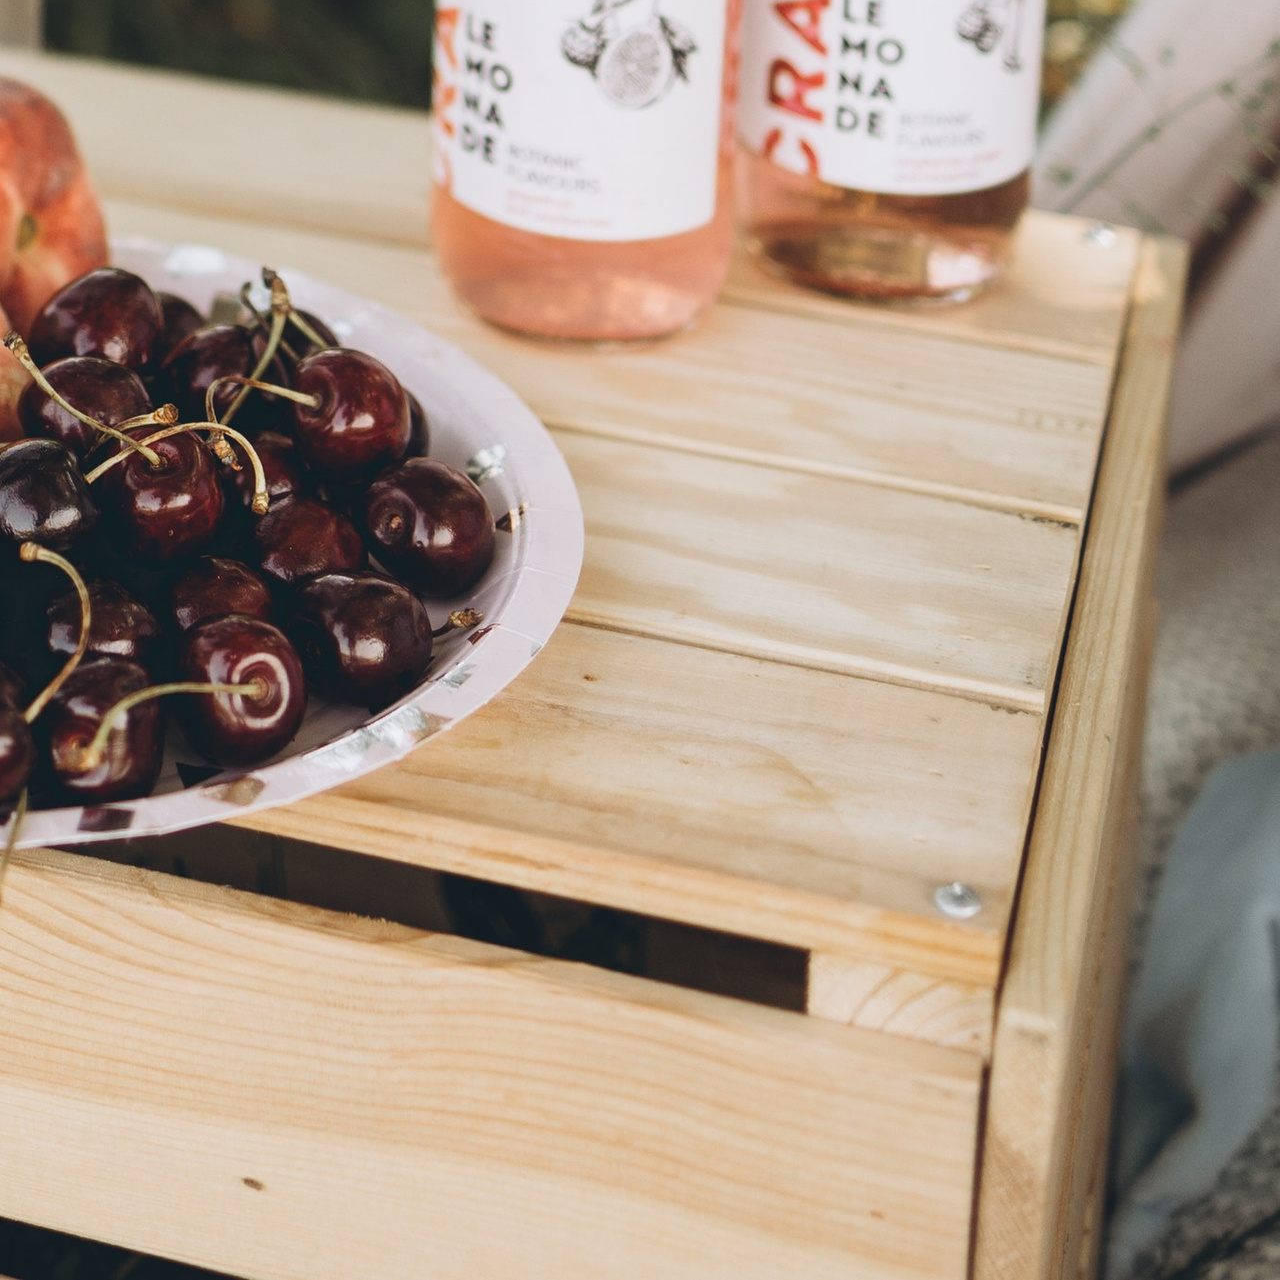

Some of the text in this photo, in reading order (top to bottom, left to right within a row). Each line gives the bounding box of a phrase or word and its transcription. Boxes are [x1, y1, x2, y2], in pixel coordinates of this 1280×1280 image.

[465, 13, 494, 52] LE
[838, 36, 906, 65] MO
[465, 54, 513, 93] MO
[837, 71, 893, 101] NA
[834, 105, 883, 139] DE
[461, 122, 495, 166] DE
